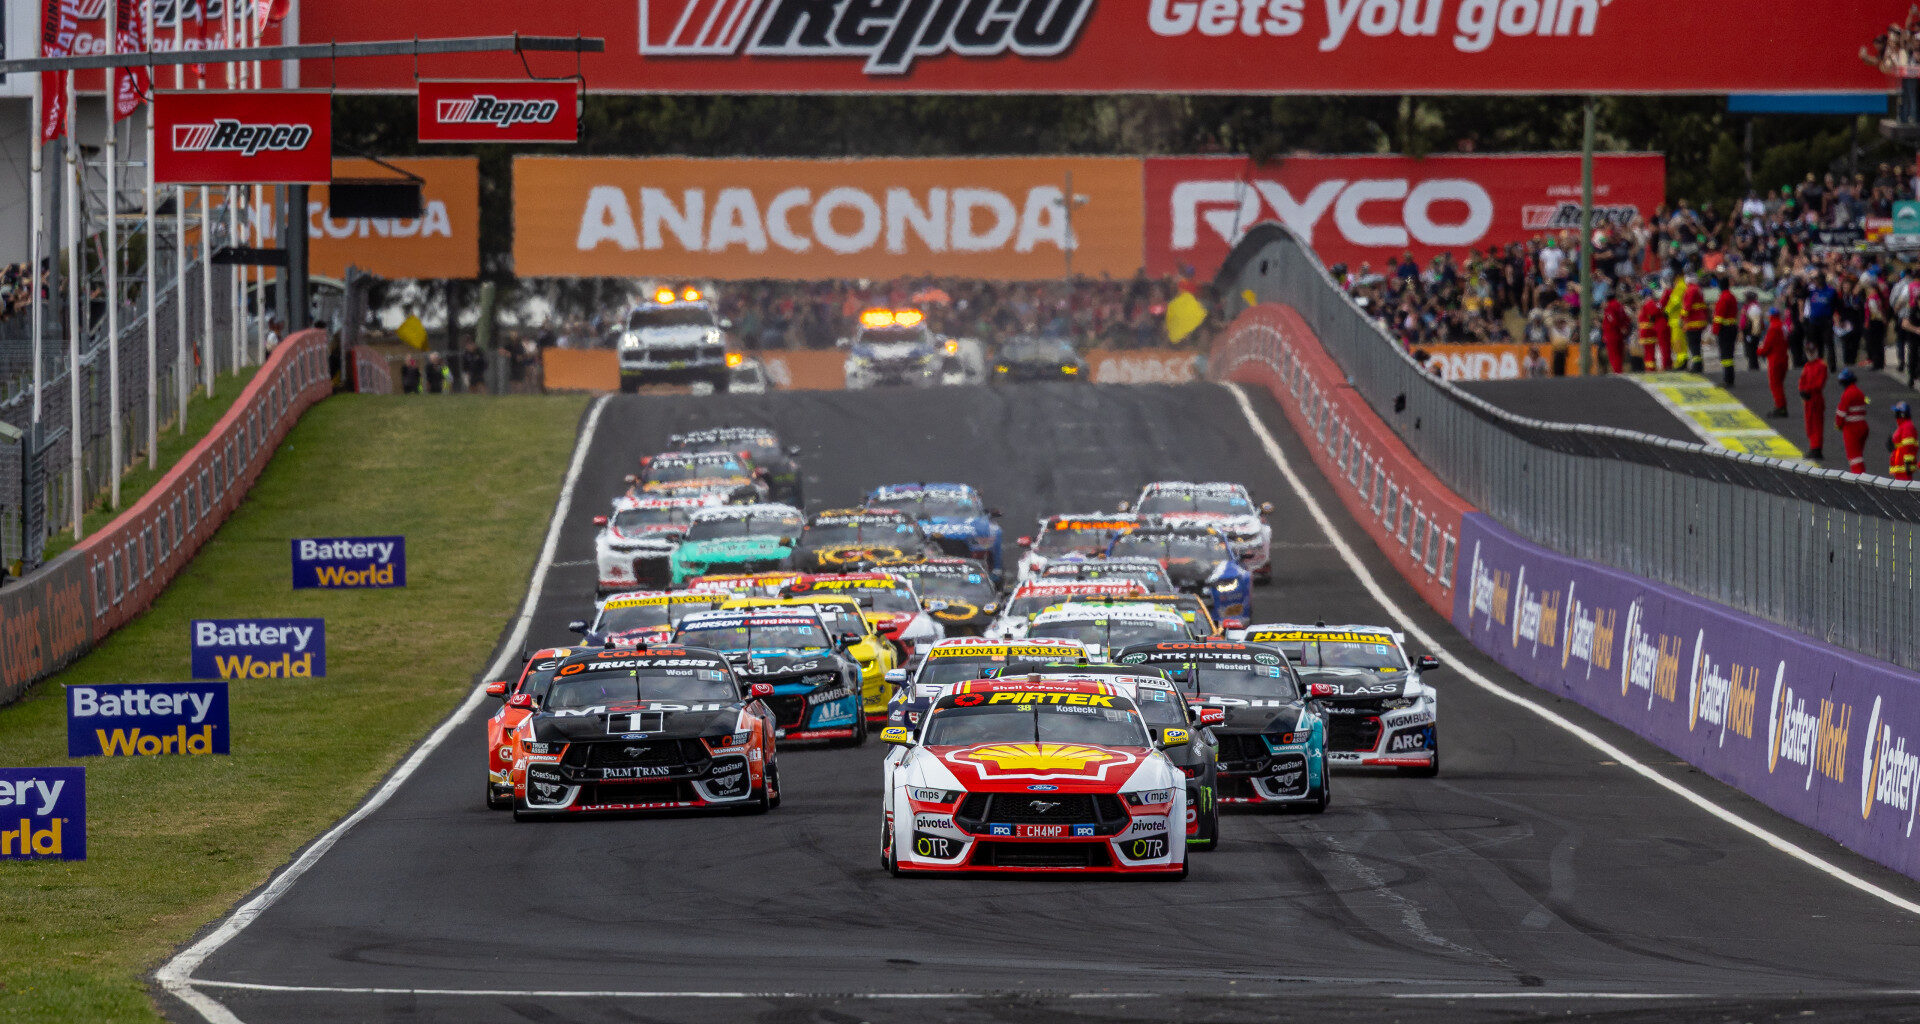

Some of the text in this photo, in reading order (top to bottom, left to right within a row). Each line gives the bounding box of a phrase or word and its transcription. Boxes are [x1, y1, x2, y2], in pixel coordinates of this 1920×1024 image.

[1147, 0, 1305, 36] Gets
[1318, 0, 1445, 52] you
[467, 94, 560, 128] Repco
[208, 118, 313, 156] Repco
[577, 185, 1078, 254] ANACONDA
[1170, 178, 1494, 249] RYCO
[299, 538, 395, 564] Battery
[316, 564, 394, 587] World
[685, 620, 743, 630] BURSON
[196, 620, 314, 652] Battery
[938, 637, 1078, 646] AMOL
[1253, 631, 1393, 645] Hydraulink
[932, 647, 1081, 657] NATIONAL STORAGE
[1150, 653, 1252, 661] NTK FILTERS
[215, 653, 312, 680] World
[588, 659, 720, 670] TRUCK ASSIST
[1215, 663, 1252, 671] Mostert
[1630, 624, 1682, 711] Battery World
[73, 687, 215, 724] Battery
[988, 692, 1117, 708] PIRTEK
[1700, 654, 1760, 748] Battery World
[554, 702, 720, 717] Mobil
[1056, 705, 1098, 715] Kostecki
[625, 713, 642, 731] 1
[96, 724, 213, 757] World
[1781, 687, 1852, 791] Battery World
[603, 766, 670, 778] PALM TRANS
[1876, 724, 1919, 838] Battery
[919, 790, 940, 801] mps
[1150, 791, 1169, 802] mps
[917, 816, 954, 830] pivotel.
[993, 826, 1011, 835] PPQ
[1027, 826, 1062, 836] CH4MP
[1131, 820, 1167, 834] pivotel.
[1077, 828, 1094, 836] PPQ
[917, 837, 950, 857] OTR
[1133, 839, 1164, 858] OTR
